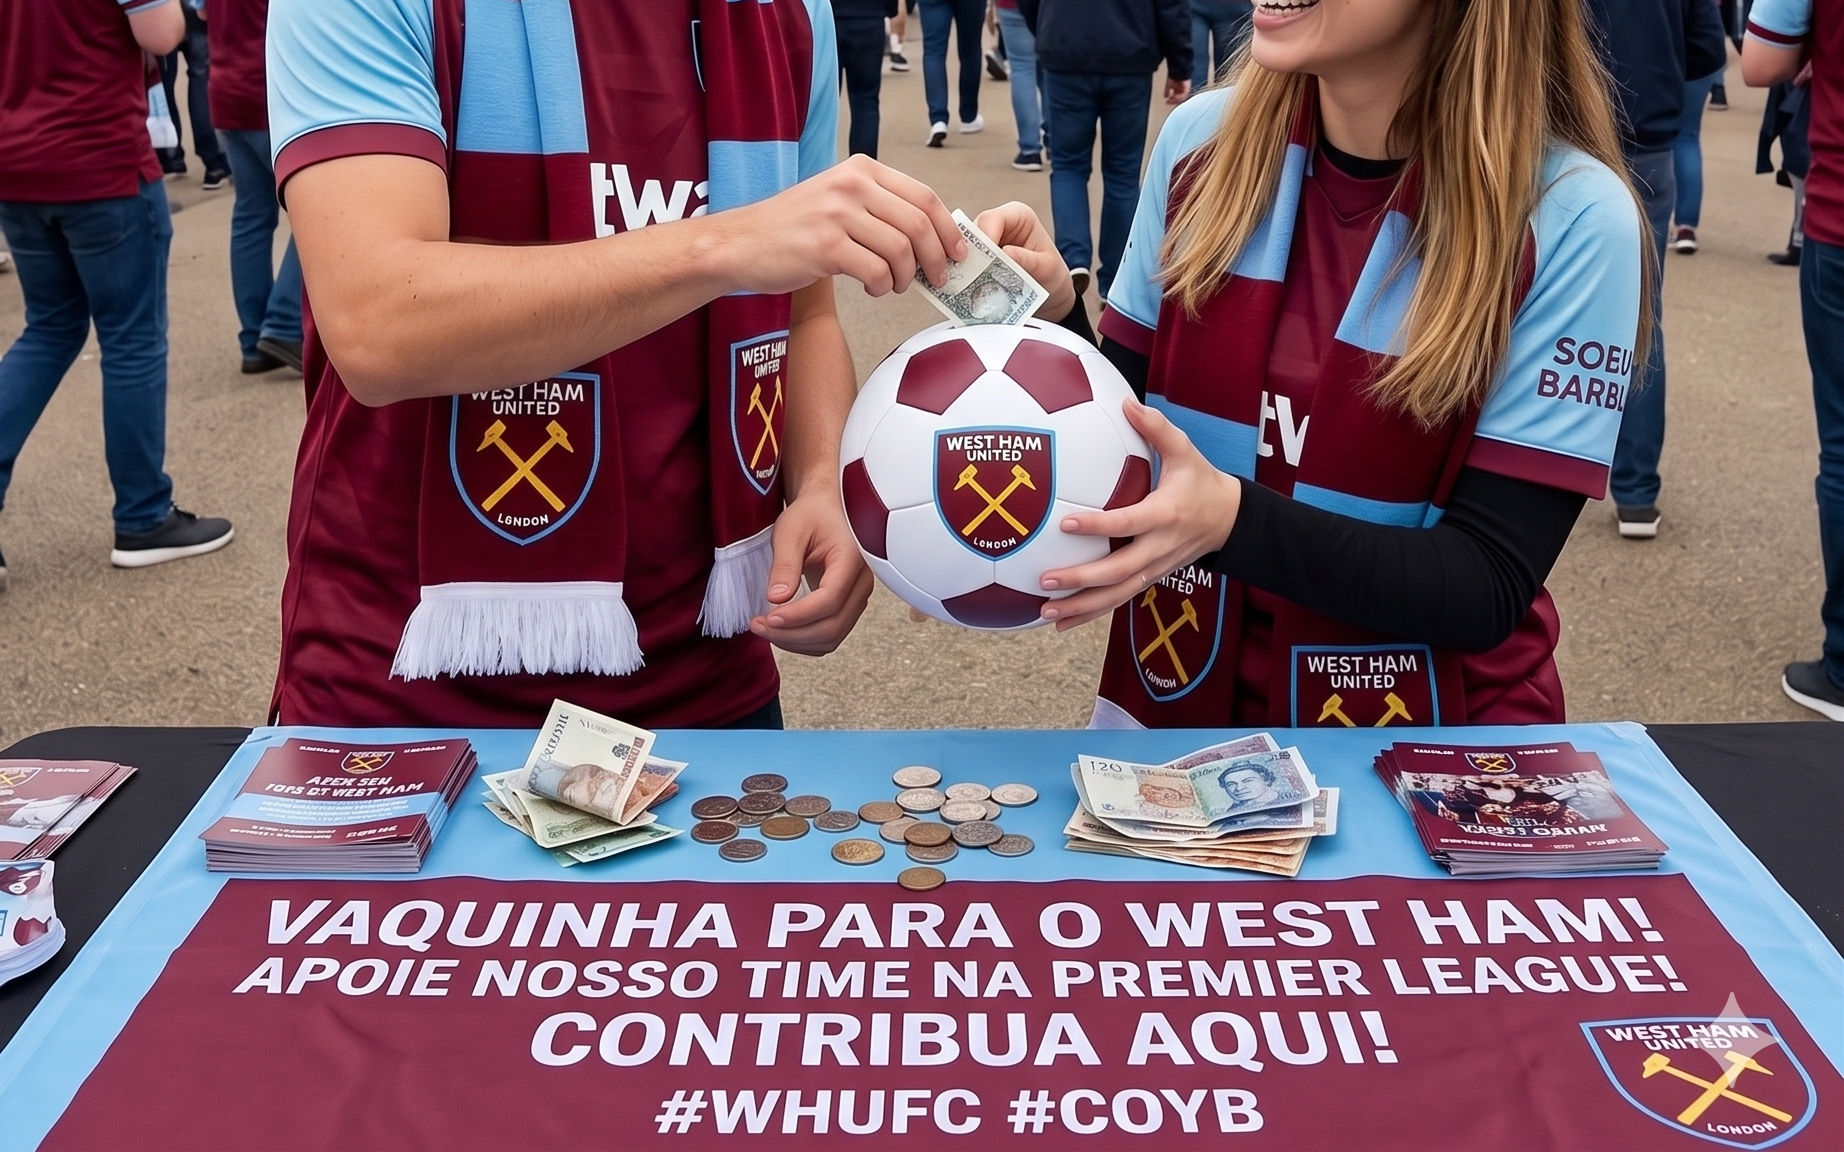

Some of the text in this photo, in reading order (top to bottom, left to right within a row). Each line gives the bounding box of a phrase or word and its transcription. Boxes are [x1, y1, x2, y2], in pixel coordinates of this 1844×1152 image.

[741, 344, 771, 367] WEST
[533, 381, 584, 402] HAM
[492, 400, 560, 416] UNITED
[946, 435, 1042, 451] WEST HAM
[966, 449, 1022, 461] UNITED
[1307, 654, 1417, 674] WEST HAM
[1330, 674, 1395, 689] UNITED
[266, 897, 1665, 952] VAQUINHA PARA O WEST HAM!
[232, 954, 1688, 999] APOIE NOSSO TIME NA PREMIER LEAGUE!
[529, 1010, 1400, 1073] CONTRIBUA AQUI!
[1605, 1024, 1758, 1042] WEST HAM
[1643, 1037, 1733, 1051] UNITED
[653, 1088, 1266, 1135] #WHUFC #COYB
[1707, 1121, 1777, 1135] LONDON
